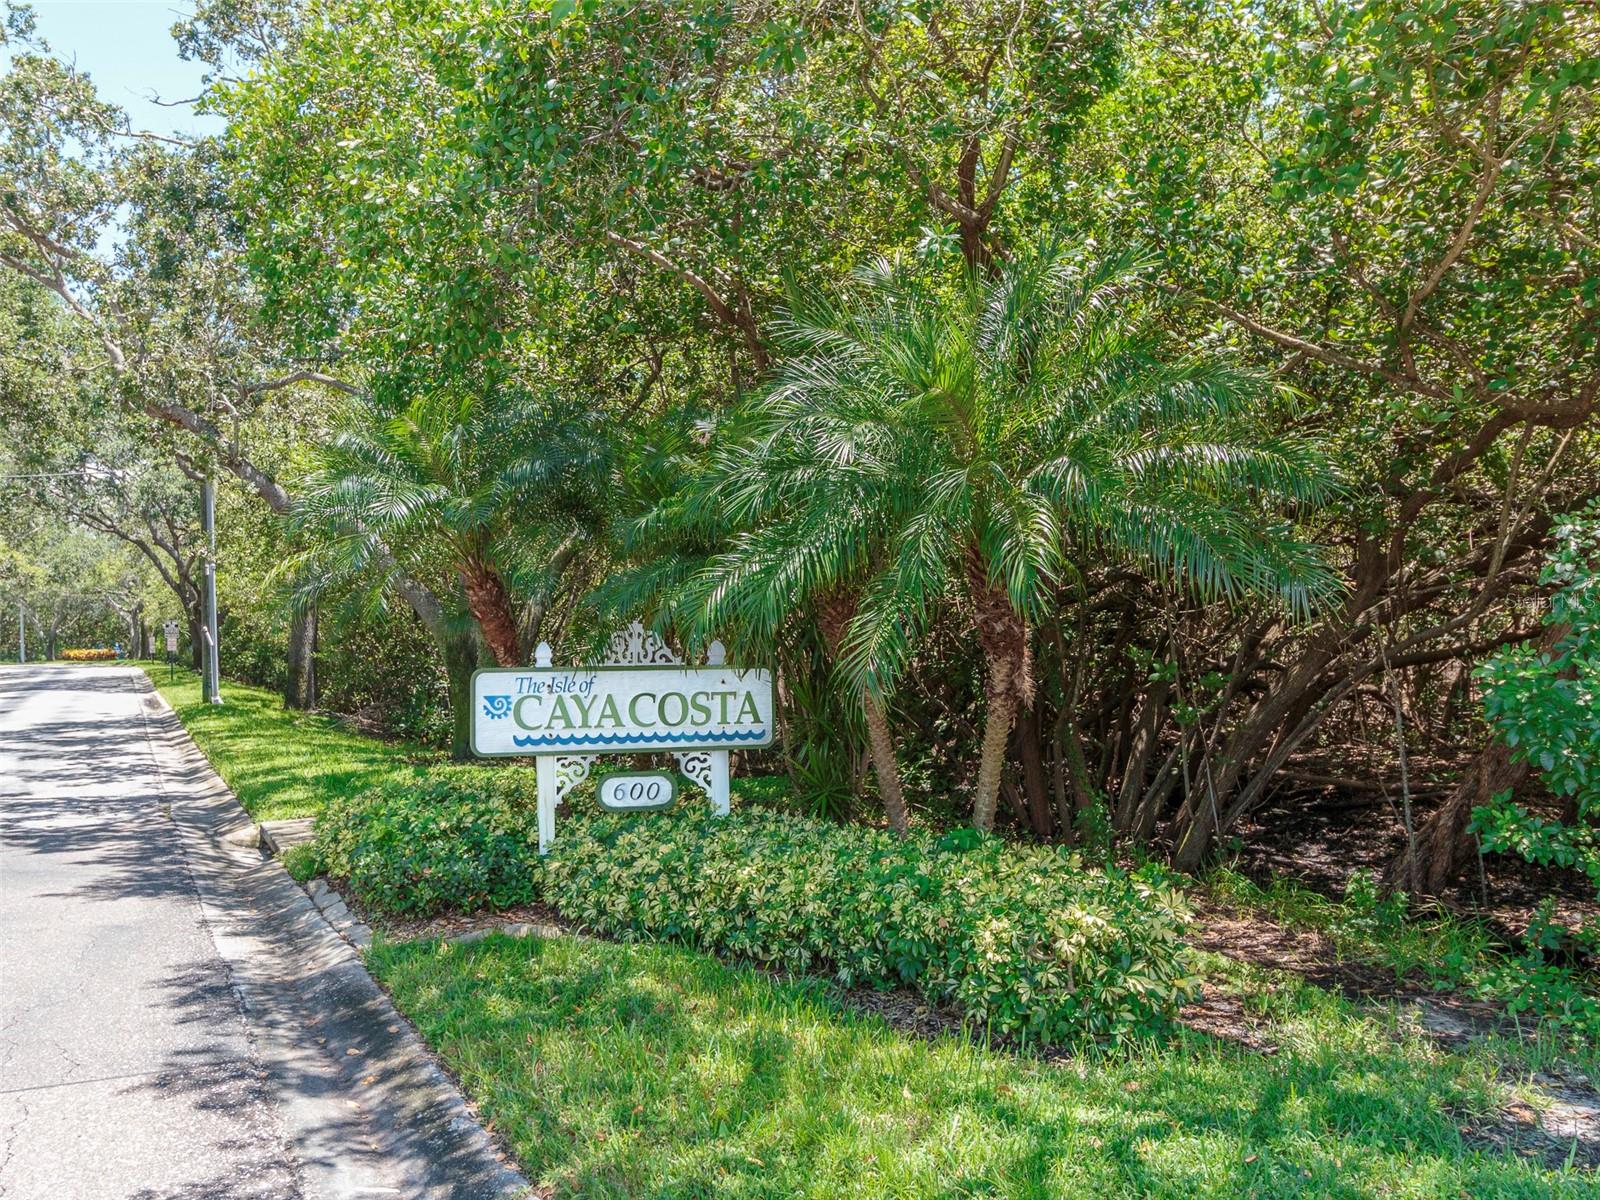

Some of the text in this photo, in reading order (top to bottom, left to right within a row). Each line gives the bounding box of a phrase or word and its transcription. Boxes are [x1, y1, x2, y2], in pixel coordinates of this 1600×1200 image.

[515, 675, 597, 699] The Isle of
[613, 782, 661, 801] 600
